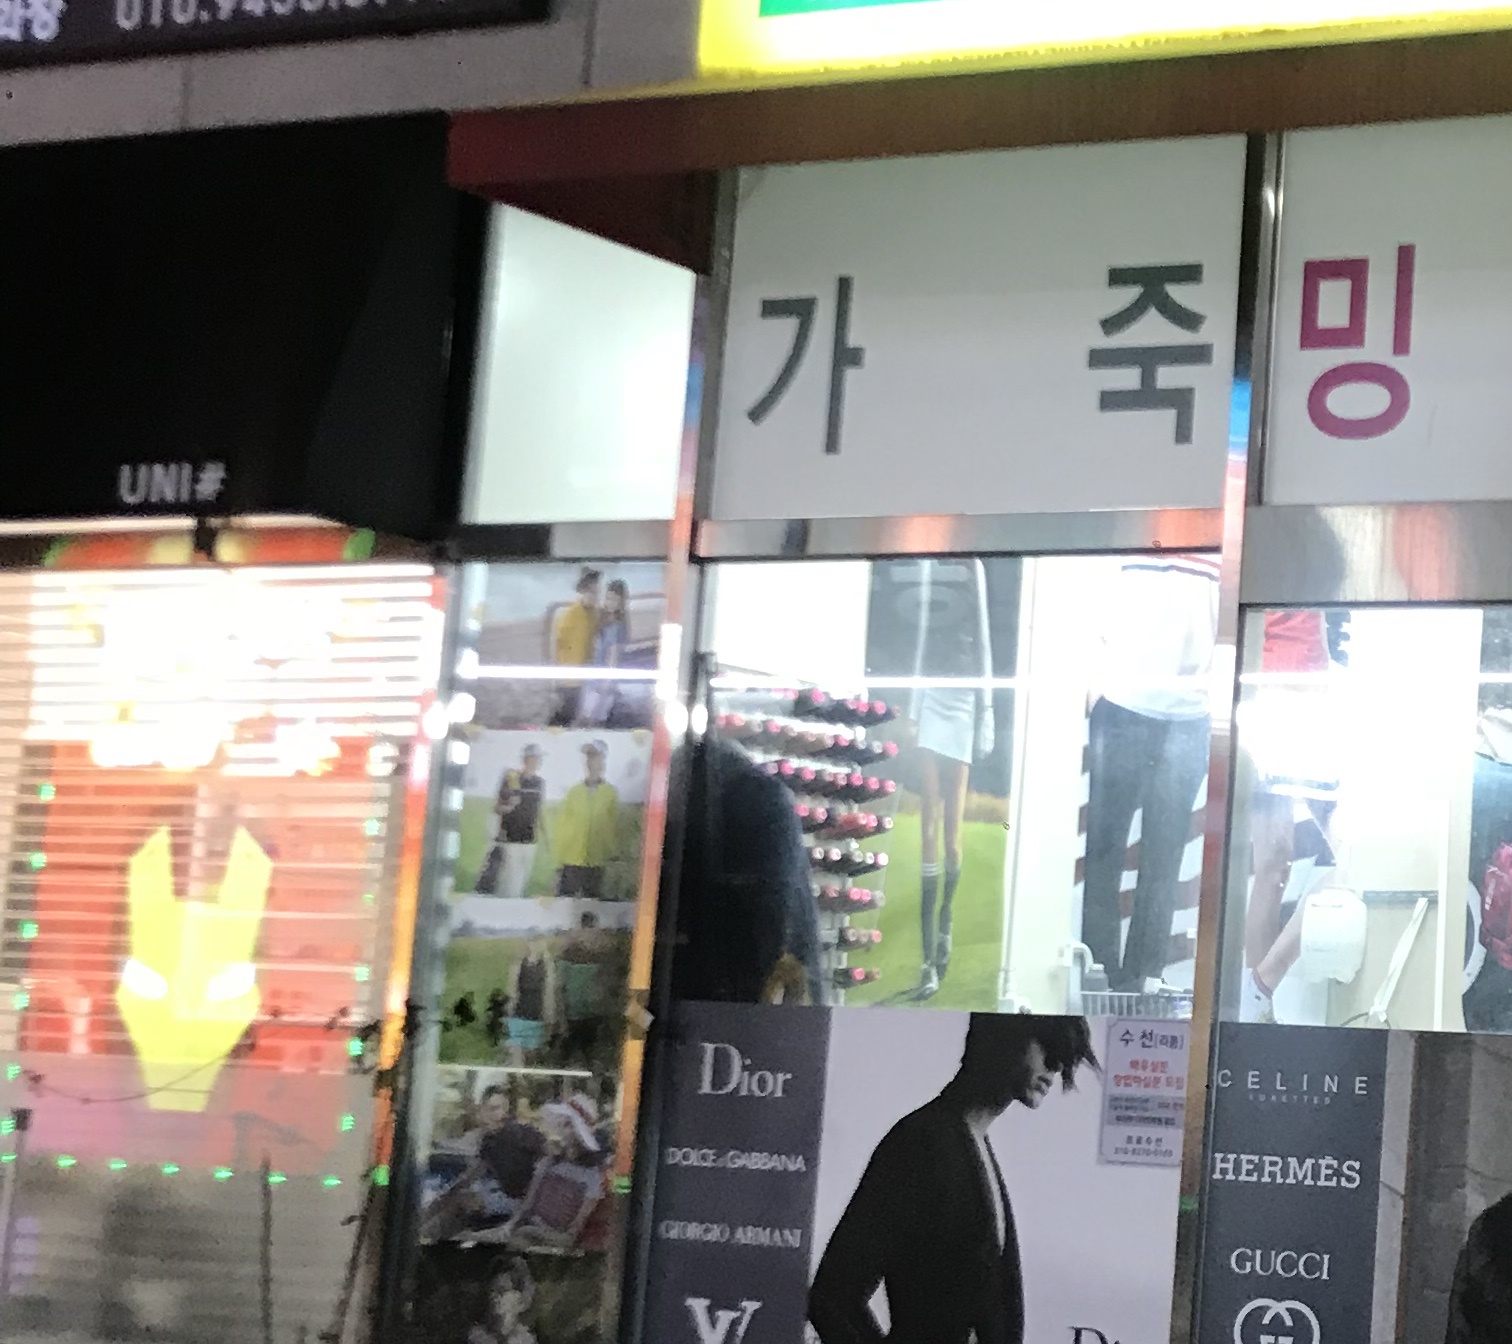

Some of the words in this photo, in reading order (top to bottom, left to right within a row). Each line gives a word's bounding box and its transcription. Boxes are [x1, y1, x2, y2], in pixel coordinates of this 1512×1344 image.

[118, 461, 227, 505] UNI#
[698, 1042, 792, 1097] Dior
[1217, 1069, 1368, 1095] CELINE
[1230, 1248, 1330, 1280] GUCCI
